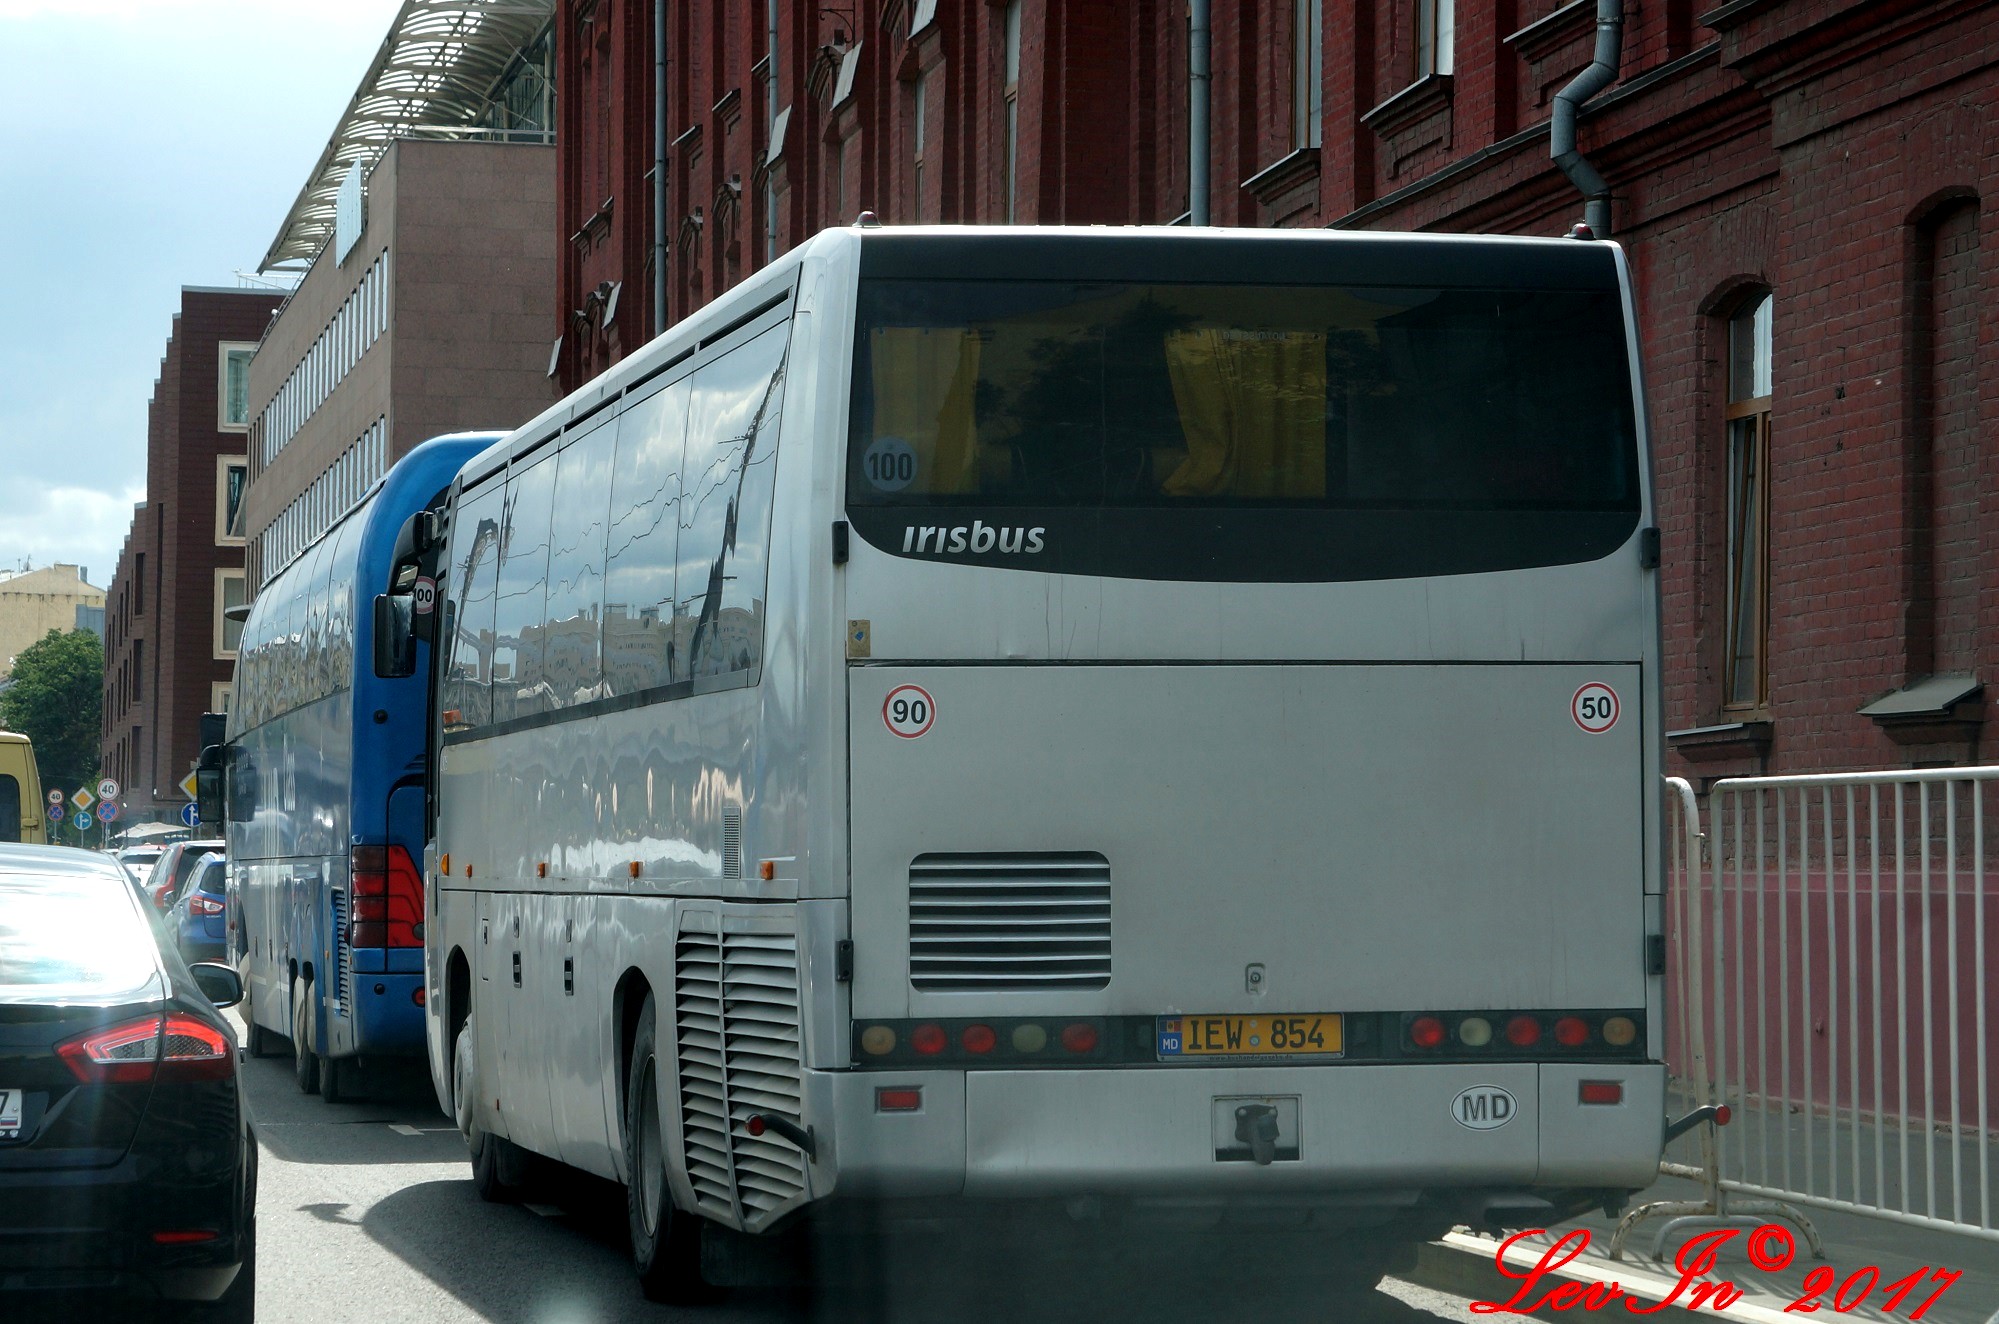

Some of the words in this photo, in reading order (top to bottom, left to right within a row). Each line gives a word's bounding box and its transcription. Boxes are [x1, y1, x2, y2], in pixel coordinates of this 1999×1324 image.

[868, 453, 912, 481] 100
[902, 520, 1046, 554] irisbus
[415, 588, 432, 603] 00
[893, 699, 926, 725] 90
[1581, 696, 1611, 719] 50
[51, 793, 61, 801] 40
[101, 784, 115, 795] 40
[1162, 1038, 1179, 1050] MD
[1270, 1018, 1325, 1049] 854
[1462, 1093, 1511, 1122] MD
